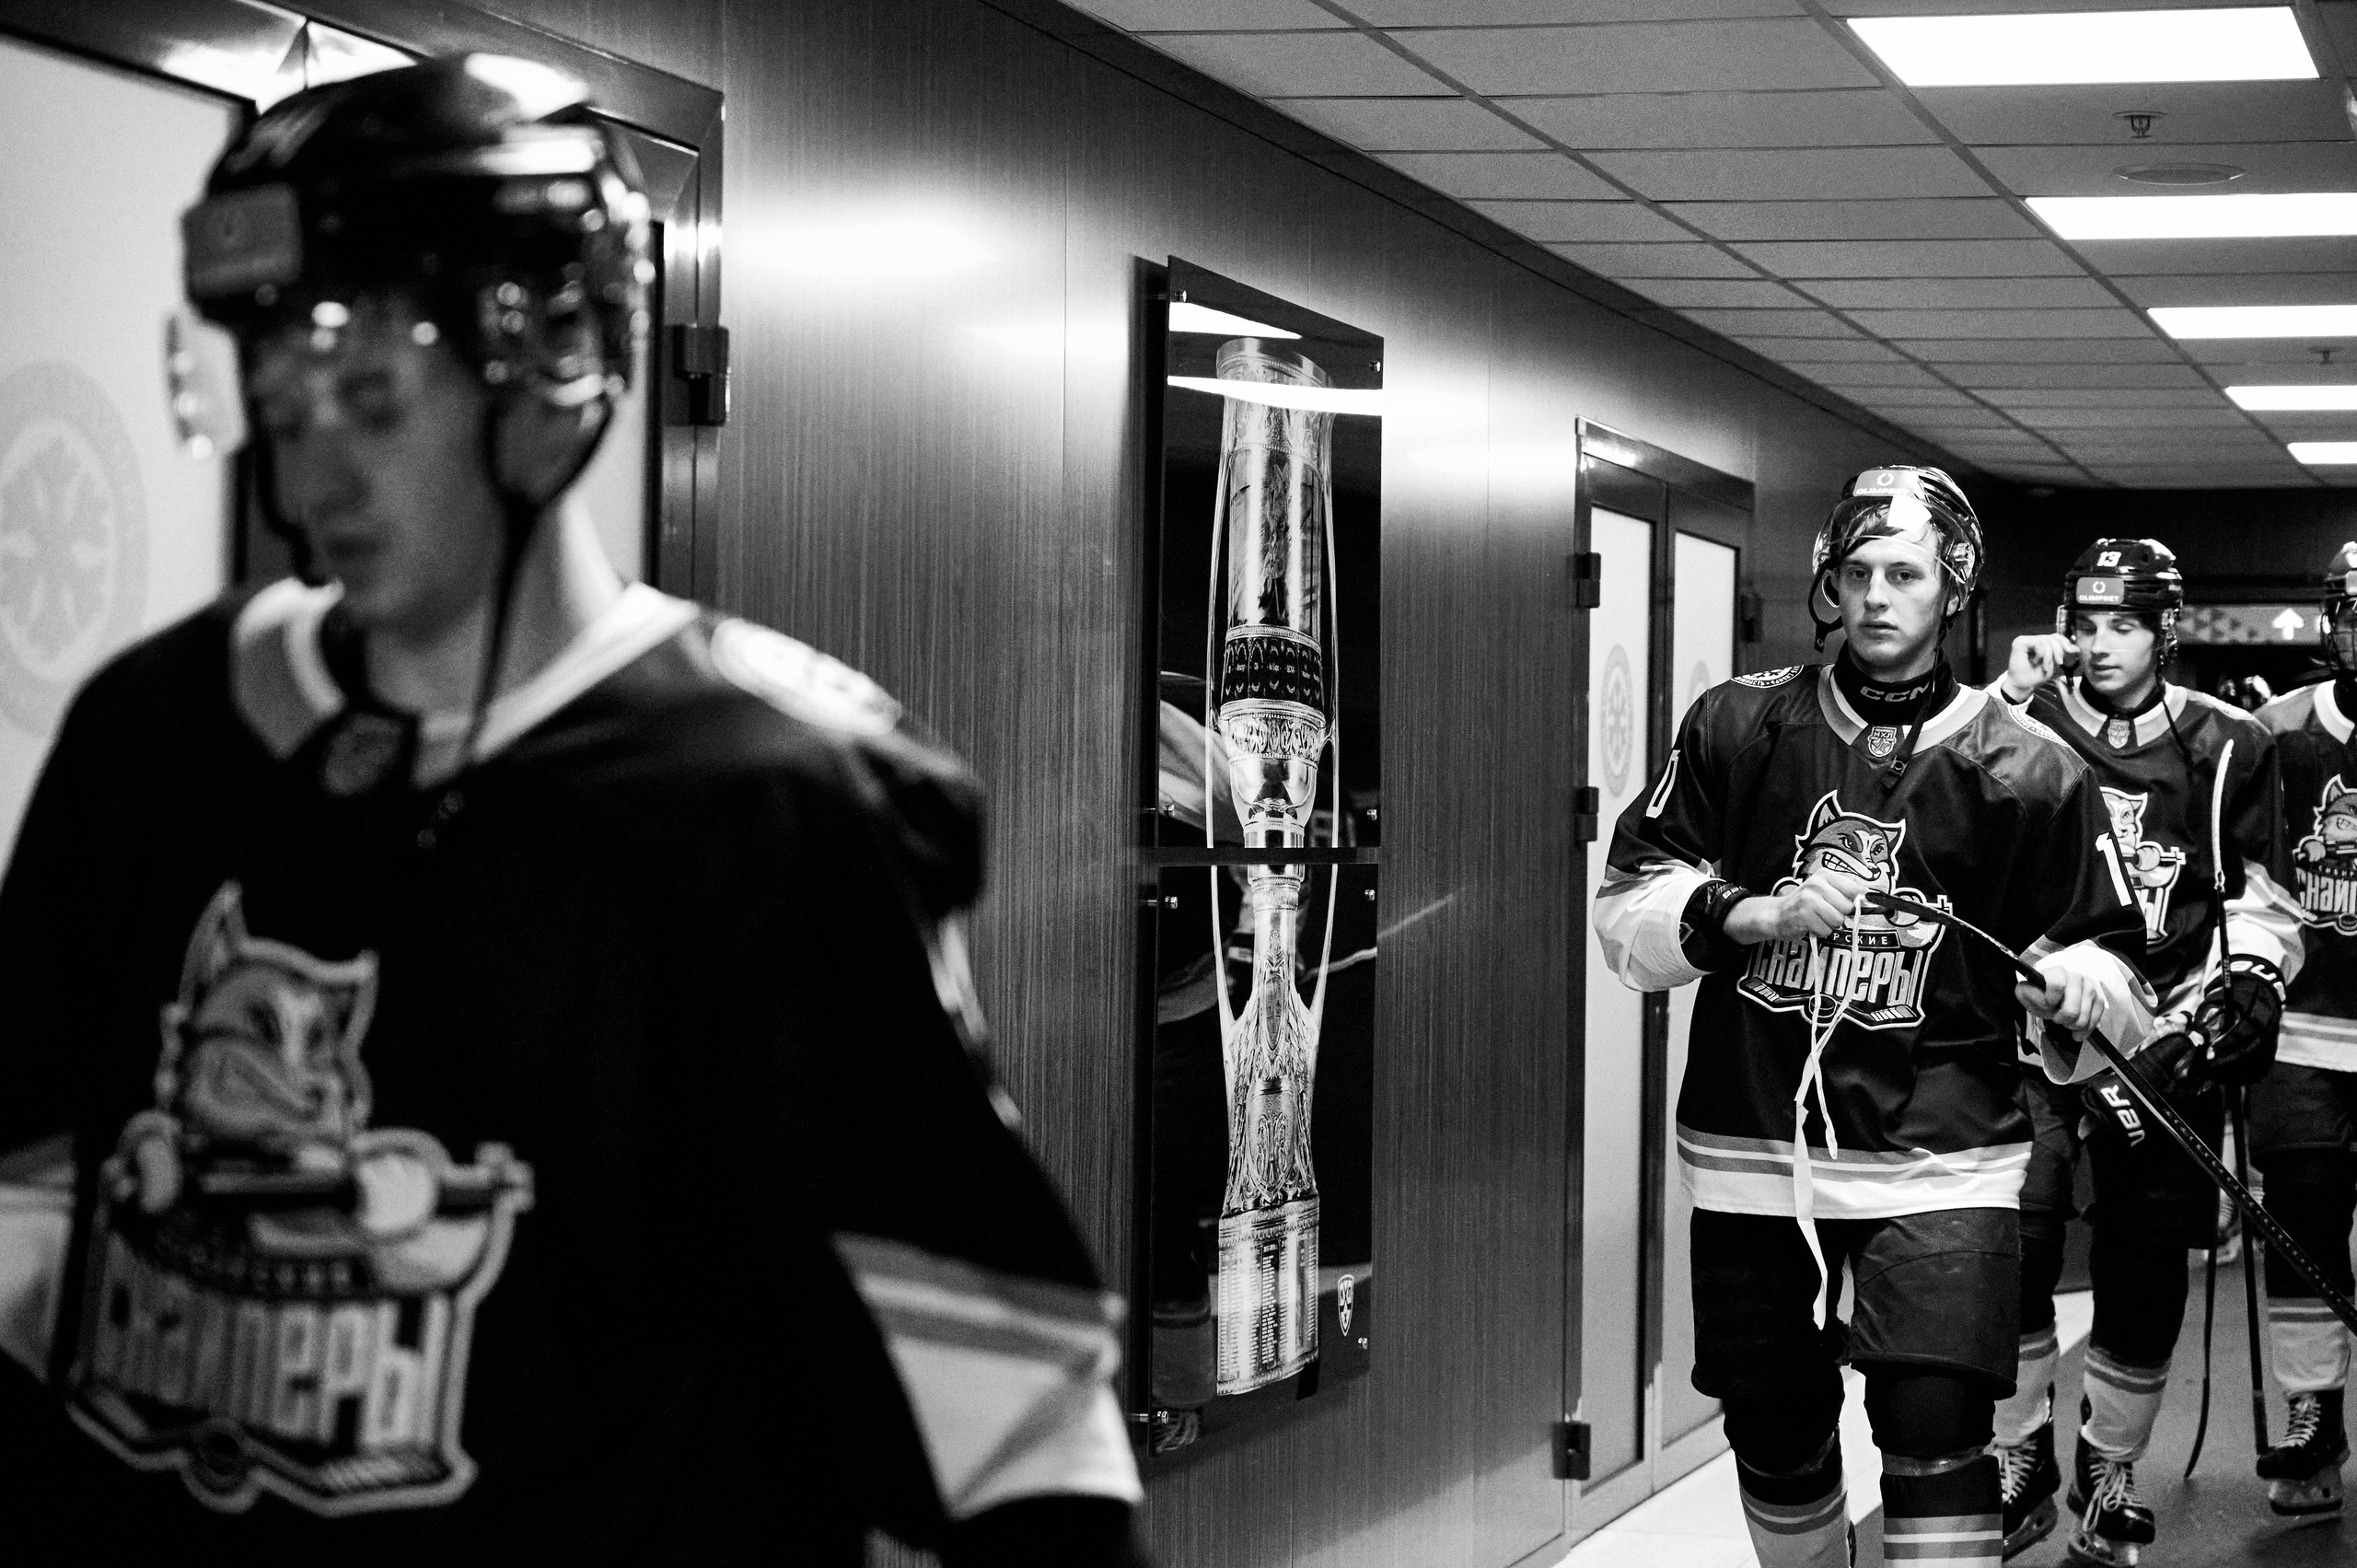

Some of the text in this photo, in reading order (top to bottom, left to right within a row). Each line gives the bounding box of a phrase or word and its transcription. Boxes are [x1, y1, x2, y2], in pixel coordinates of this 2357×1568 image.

[2096, 551, 2122, 567] 13
[2078, 594, 2120, 602] OLIMPBET
[1860, 681, 1930, 703] CCM
[2099, 1084, 2146, 1148] UER
